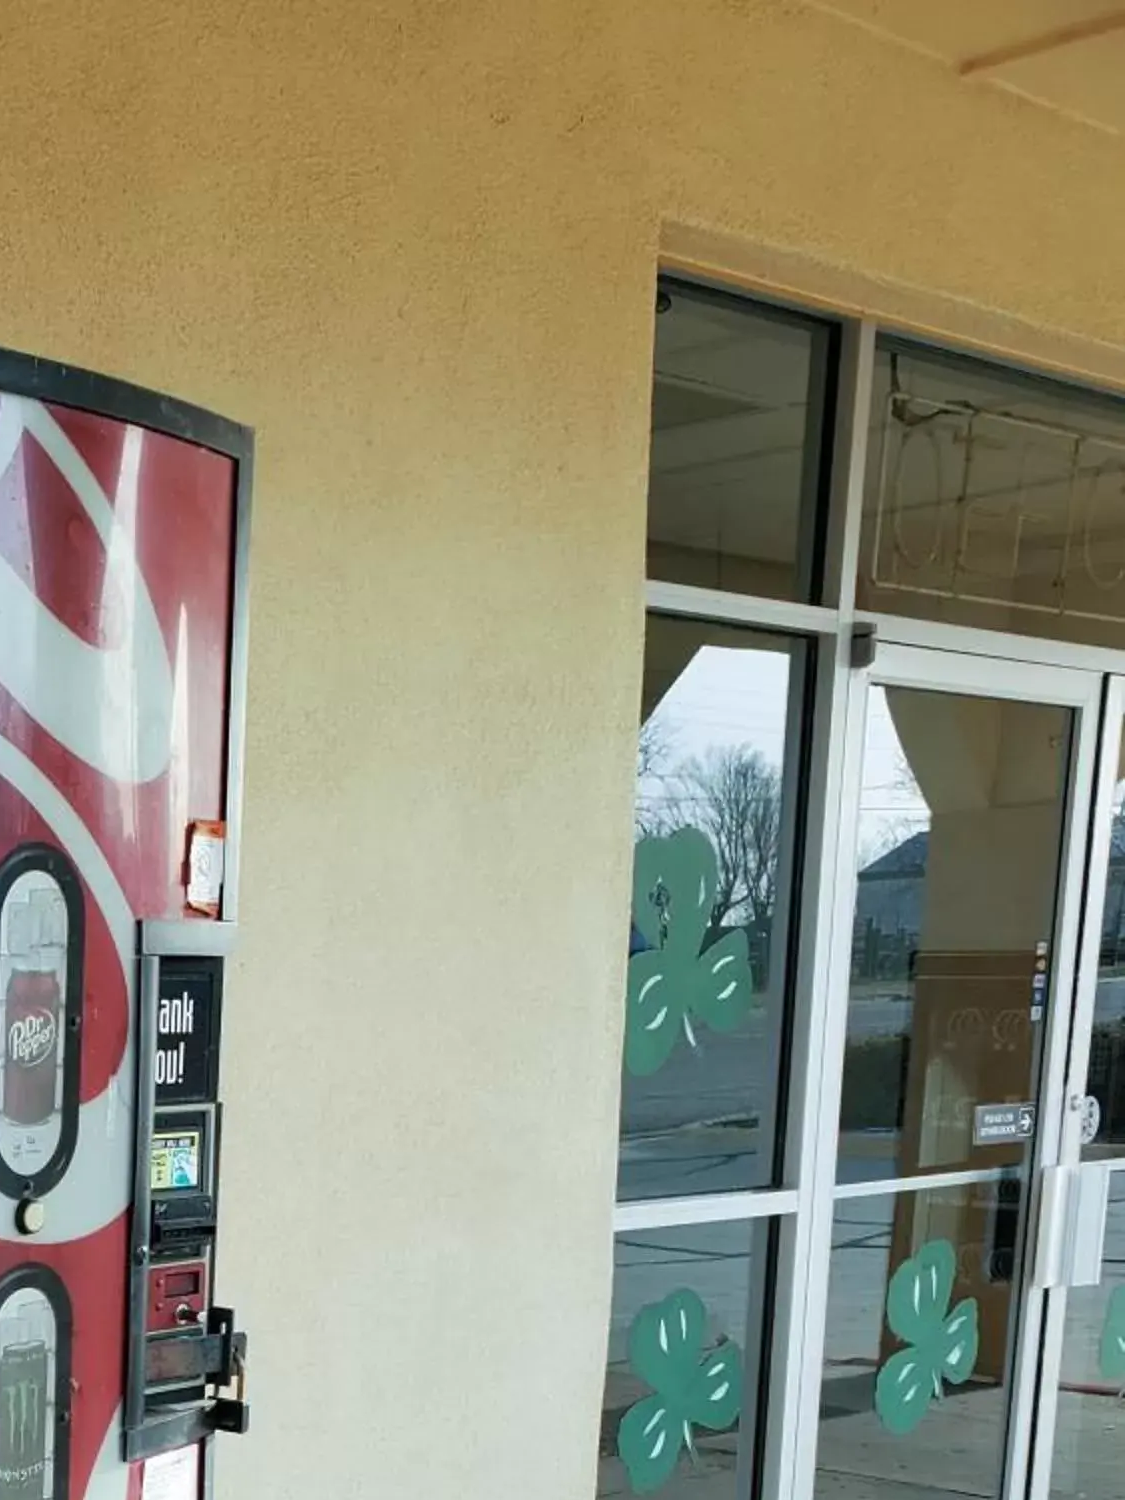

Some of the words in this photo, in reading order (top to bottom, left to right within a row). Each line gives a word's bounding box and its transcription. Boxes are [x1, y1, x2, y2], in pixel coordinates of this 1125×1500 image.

[25, 1015, 44, 1037] Dr
[158, 991, 194, 1034] ank
[9, 1021, 54, 1060] Pepper
[154, 1041, 185, 1085] ou!
